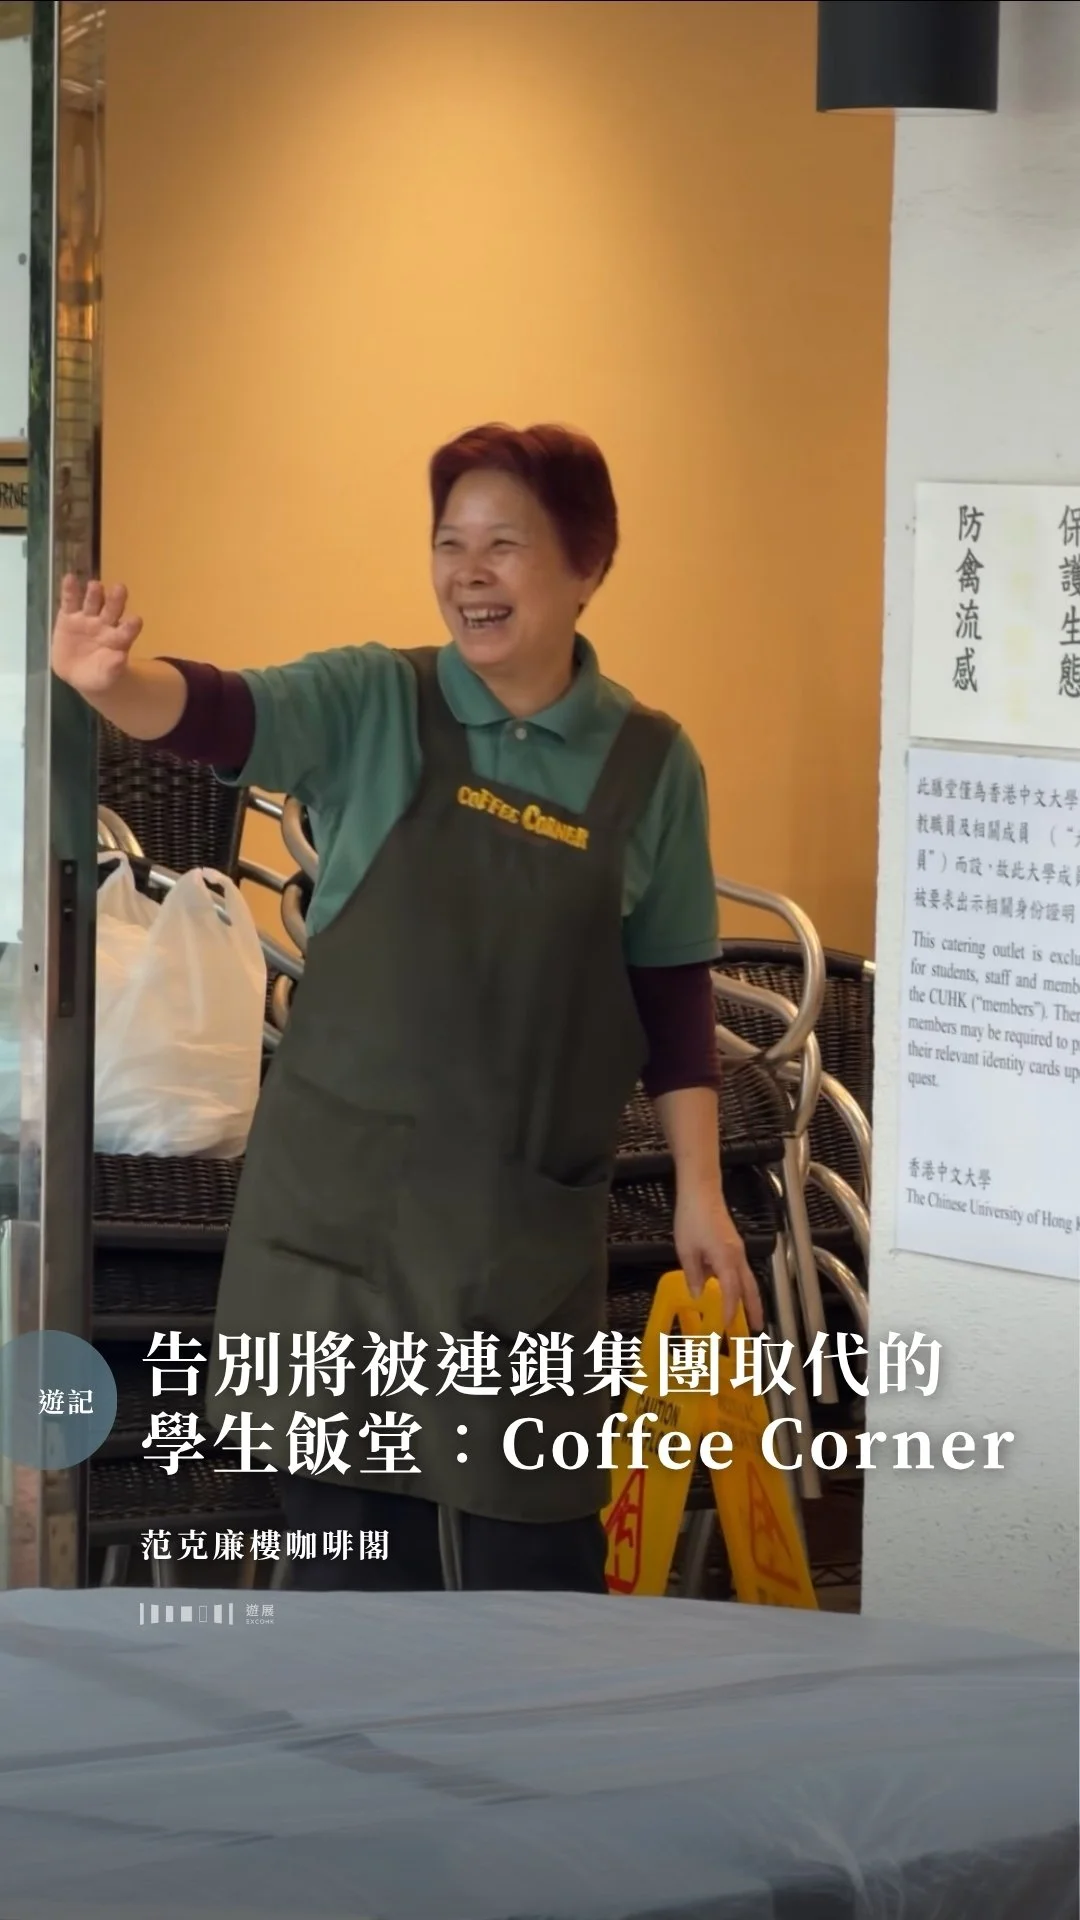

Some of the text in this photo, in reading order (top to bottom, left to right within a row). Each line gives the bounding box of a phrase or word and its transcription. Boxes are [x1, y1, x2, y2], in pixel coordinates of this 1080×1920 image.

[952, 505, 985, 693] 防禽流感
[916, 813, 1029, 844] 教職員及相關成員
[914, 887, 1076, 924] 被要求出示相關身份證明
[912, 930, 935, 949] This
[941, 937, 986, 959] catering
[992, 942, 1025, 960] outlet
[1032, 944, 1043, 961] is
[910, 957, 926, 975] for
[931, 962, 979, 984] students,
[985, 969, 1012, 986] staff
[1015, 973, 1037, 989] and
[909, 985, 926, 1003] the
[929, 987, 967, 1008] CUHK
[908, 1016, 957, 1035] members
[960, 1024, 984, 1042] may
[988, 1024, 1002, 1041] be
[1004, 1029, 1053, 1048] required
[1056, 1035, 1068, 1050] to
[908, 1040, 932, 1058] their
[935, 1044, 979, 1066] relevant
[982, 1050, 1026, 1076] identity
[1029, 1060, 1061, 1077] cards
[908, 1071, 939, 1088] quest.
[908, 1156, 992, 1191] 香港中文大學
[906, 1187, 926, 1206] The
[927, 1191, 967, 1213] Chinese
[970, 1199, 1024, 1226] University
[1027, 1209, 1040, 1225] of
[1042, 1210, 1073, 1235] Hong
